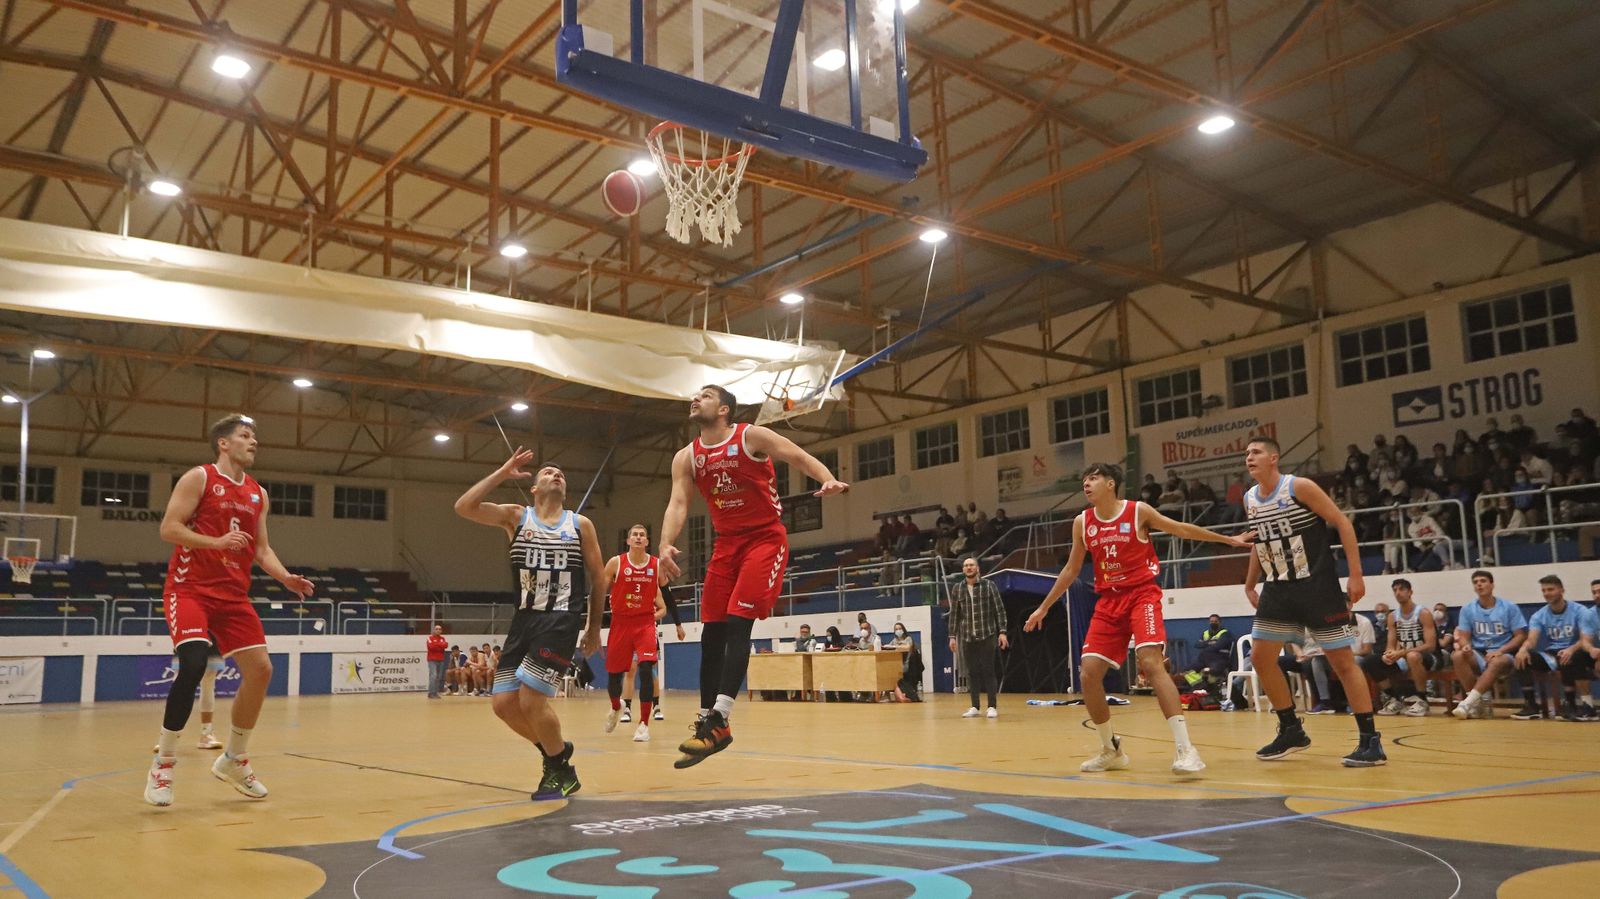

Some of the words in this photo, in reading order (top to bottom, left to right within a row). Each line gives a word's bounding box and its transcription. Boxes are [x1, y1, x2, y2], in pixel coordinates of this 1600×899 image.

[1447, 367, 1543, 419] STROG
[1176, 417, 1259, 440] SUPERMERCADOS
[713, 471, 732, 488] 24
[230, 517, 241, 531] 6
[1256, 517, 1293, 541] ULB
[525, 547, 569, 570] ULB
[1103, 544, 1118, 559] 14
[635, 583, 641, 593] 3
[1474, 620, 1506, 635] ULB
[373, 656, 421, 665] Gimnasio
[373, 666, 405, 675] Forma
[373, 676, 409, 685] Fitness
[581, 807, 820, 835] baloncesto
